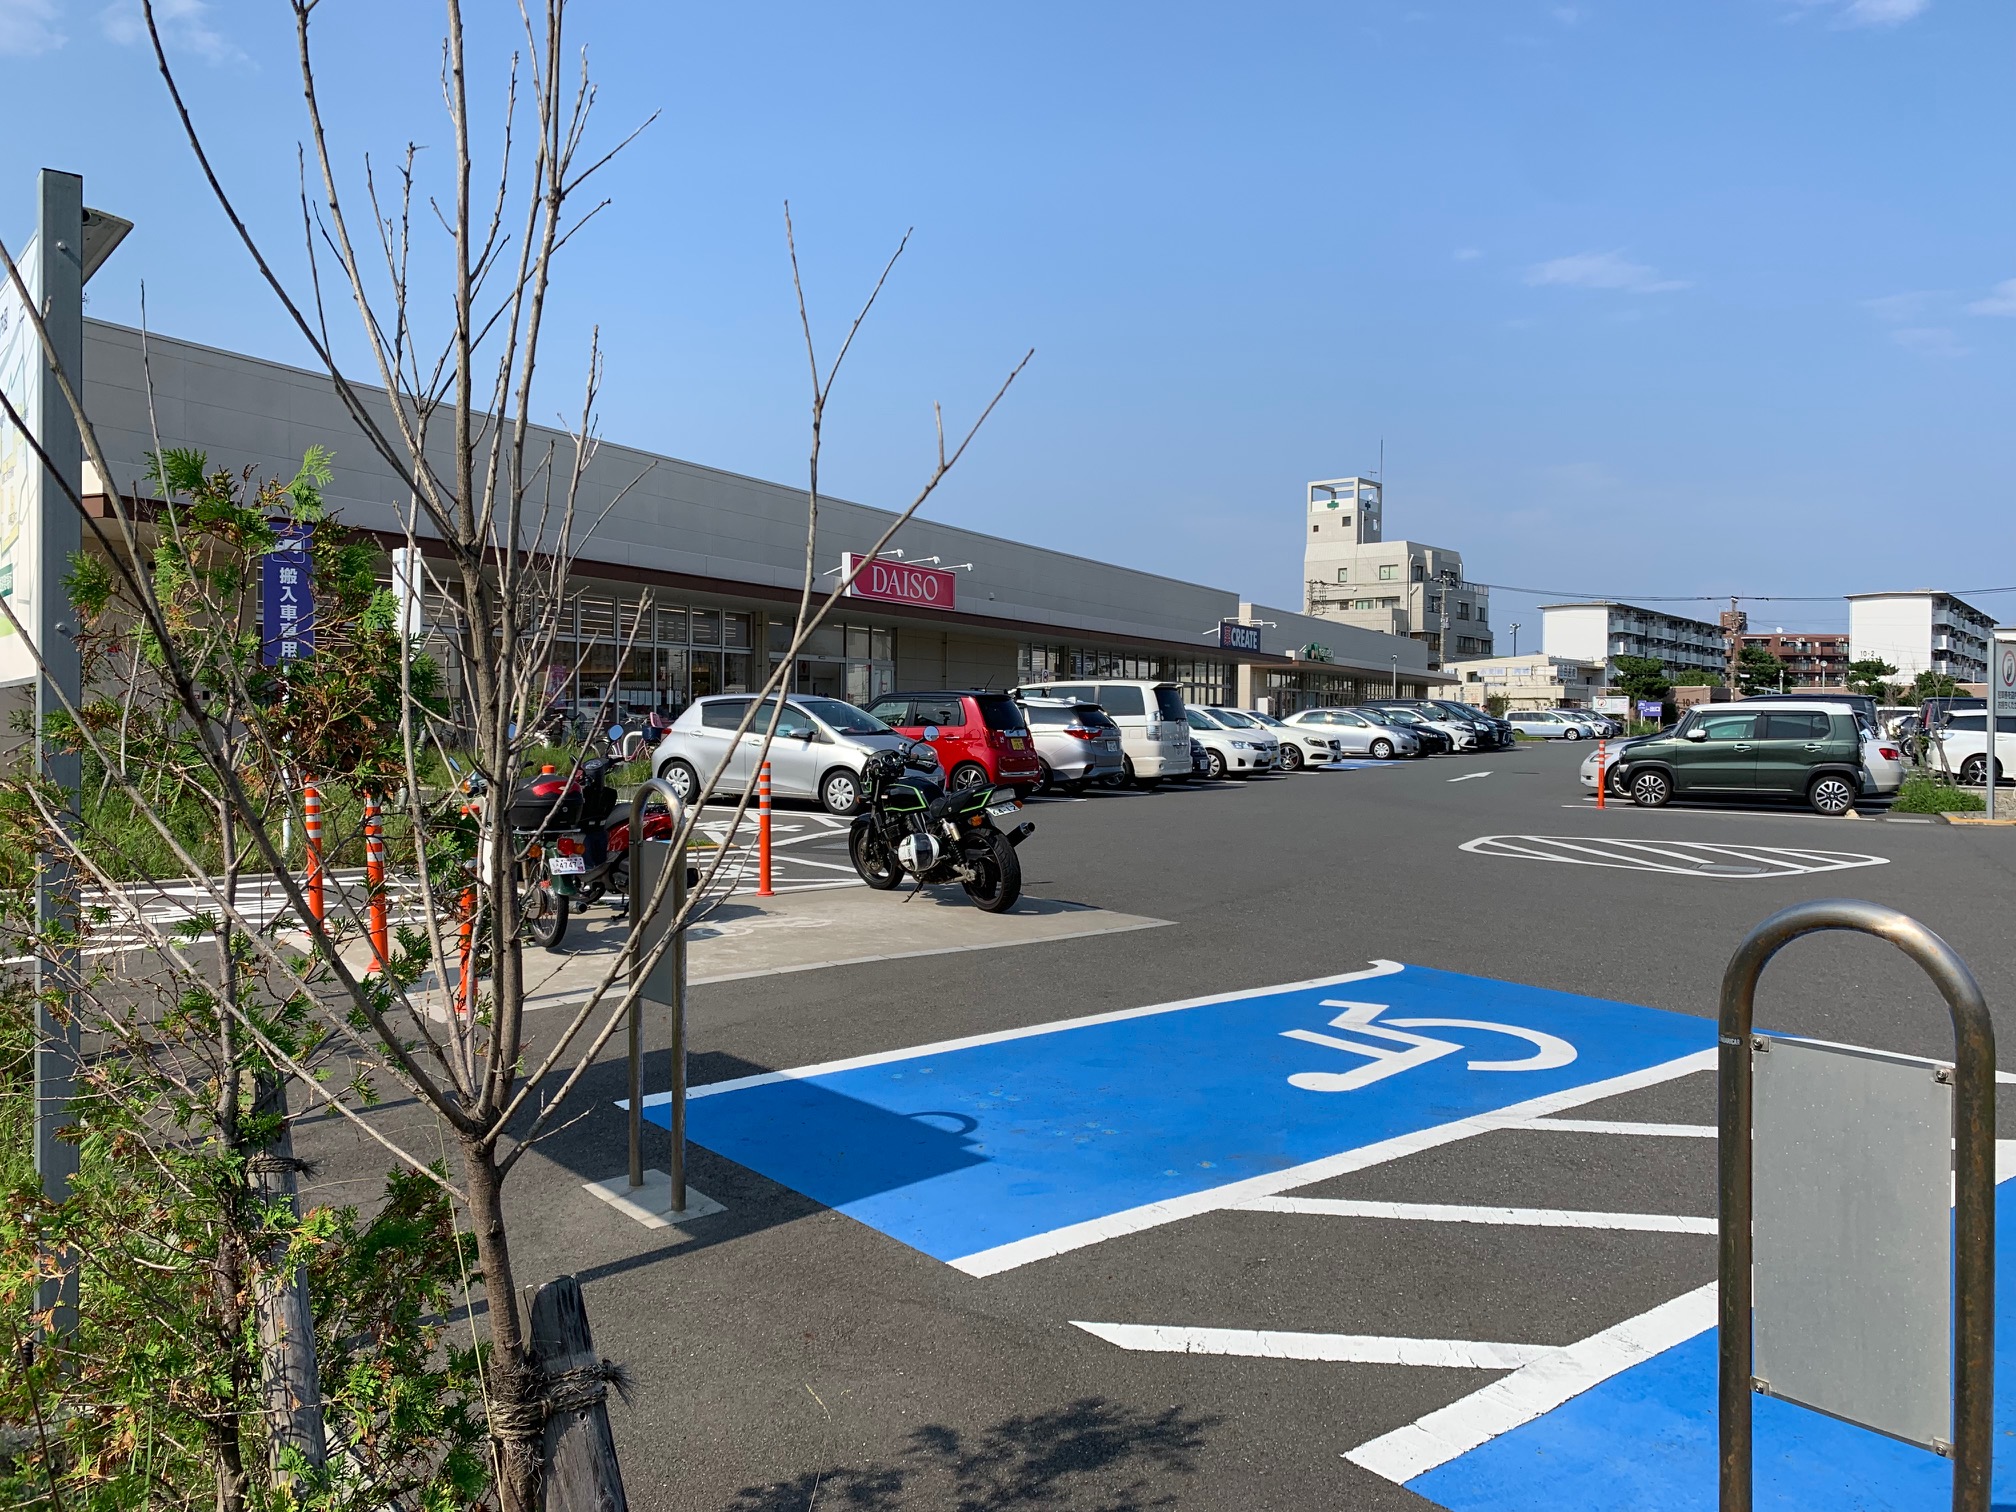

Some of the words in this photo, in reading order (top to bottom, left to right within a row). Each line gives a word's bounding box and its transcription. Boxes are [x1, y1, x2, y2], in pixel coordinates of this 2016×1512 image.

[872, 565, 938, 601] DAISO
[279, 566, 298, 658] 搬入車専用
[1231, 627, 1258, 650] CREATE
